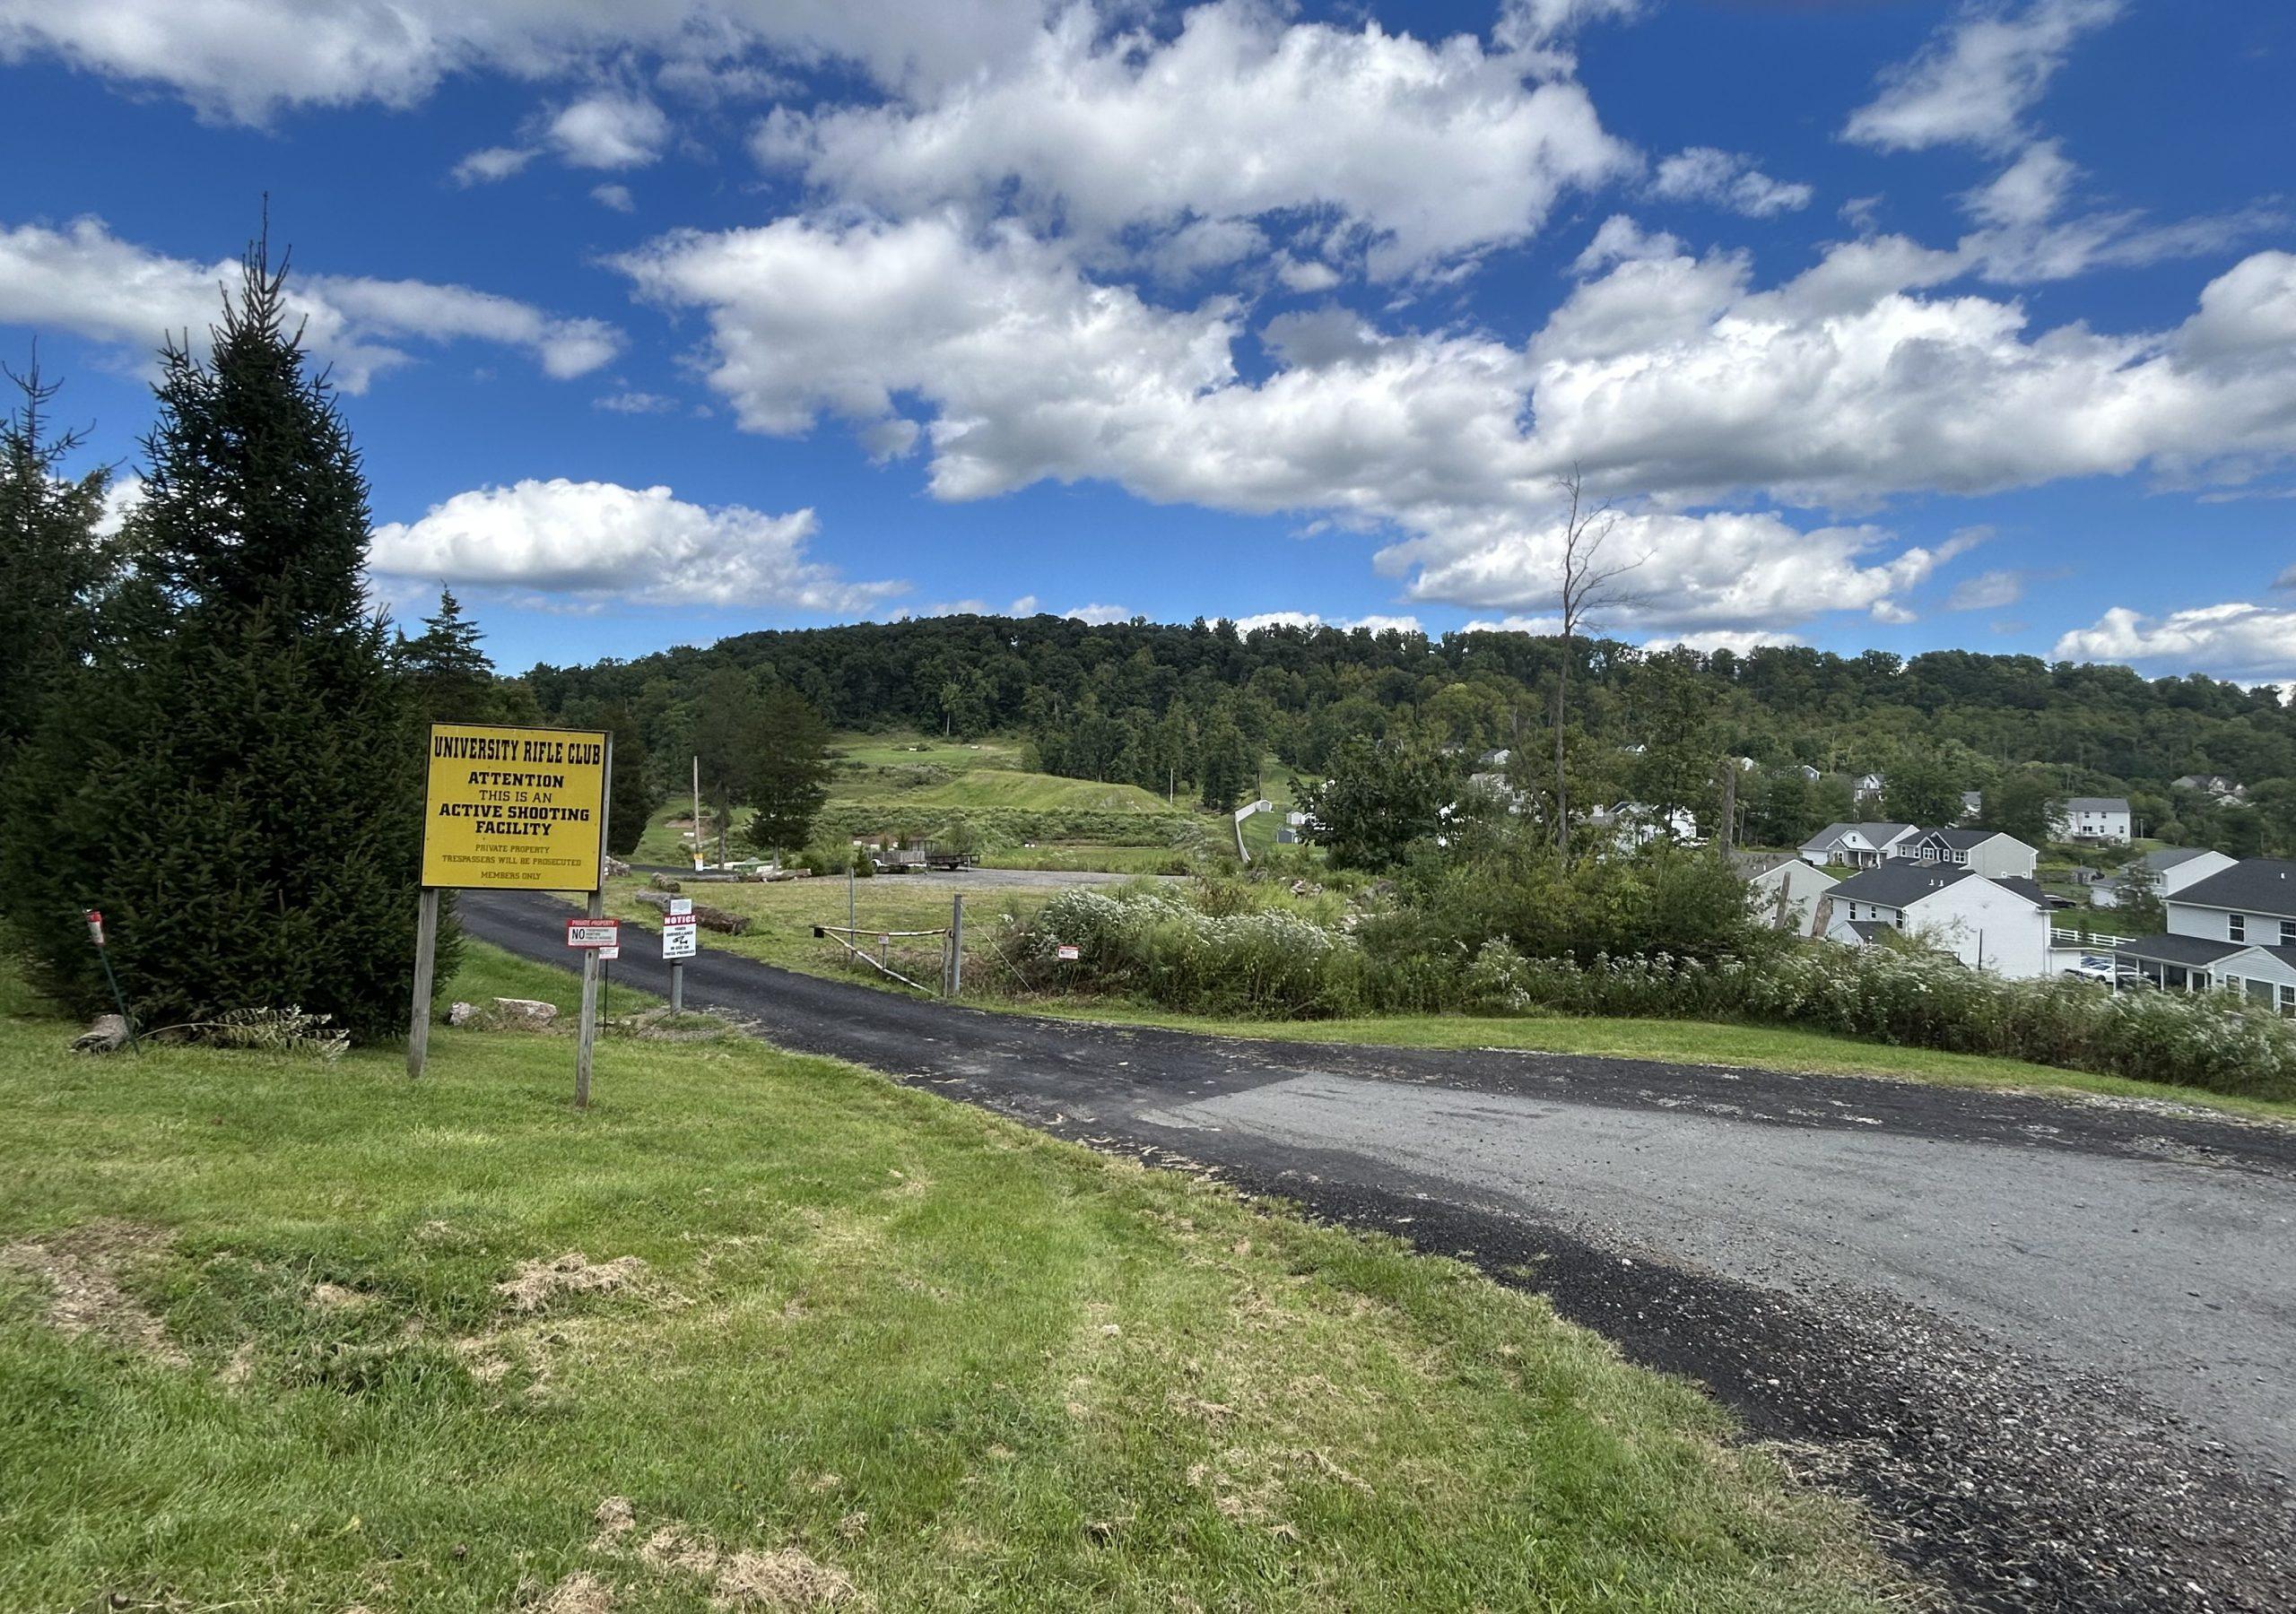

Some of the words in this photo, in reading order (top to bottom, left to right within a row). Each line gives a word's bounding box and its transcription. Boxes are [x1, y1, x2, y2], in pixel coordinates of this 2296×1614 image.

[435, 735, 518, 761] UNIVERSITY
[524, 741, 563, 763] RIFLE
[568, 743, 601, 765] CLUB
[468, 771, 564, 788] ATTENTION
[480, 790, 510, 802] THIS
[516, 791, 527, 803] IS
[532, 792, 552, 803] AN
[439, 803, 502, 818] ACTIVE
[508, 806, 589, 821] SHOOTING
[475, 821, 552, 836] FACILITY
[475, 845, 509, 853] PRIVATE
[510, 846, 550, 854] PROPERTY
[442, 855, 495, 863] TRESPASSERS
[499, 856, 517, 864] WILL
[520, 857, 530, 865] BE
[533, 858, 582, 866] PROSECUTED
[481, 872, 520, 880] MEMBERS
[522, 872, 541, 881] ONLY
[664, 915, 696, 924] NOTICE
[572, 928, 586, 940] NO
